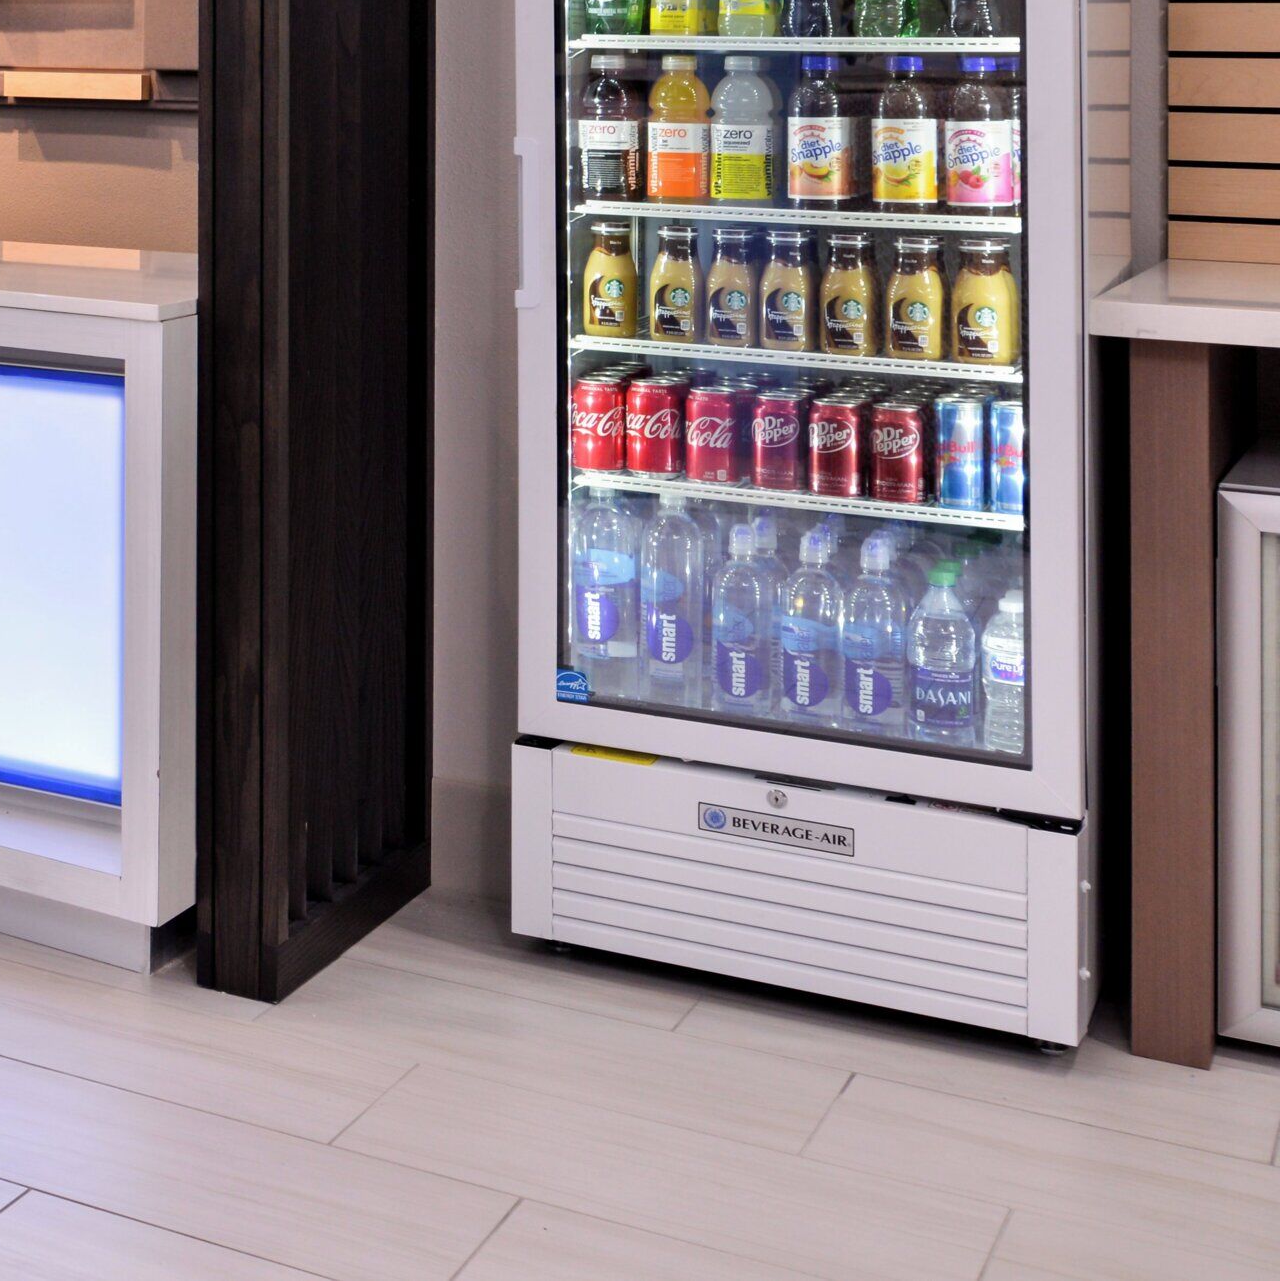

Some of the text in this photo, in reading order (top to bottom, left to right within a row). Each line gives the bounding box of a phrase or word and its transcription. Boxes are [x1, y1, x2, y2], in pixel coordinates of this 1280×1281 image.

[589, 125, 616, 135] zero
[658, 127, 687, 138] zero
[722, 129, 753, 140] zero
[791, 139, 842, 163] Snapple
[801, 139, 821, 150] diet
[880, 140, 900, 152] diet
[957, 144, 978, 155] diet
[873, 141, 922, 165] Snapple
[947, 147, 1001, 169] Snapple
[764, 416, 785, 430] Dr
[818, 421, 837, 433] Dr
[752, 419, 797, 444] Pepper
[809, 422, 851, 449] Pepper
[883, 427, 904, 441] Dr
[871, 429, 917, 455] Pepper
[991, 660, 1012, 672] Pure
[915, 686, 971, 708] DASANI
[732, 816, 848, 847] BEVERAGE-AIR
